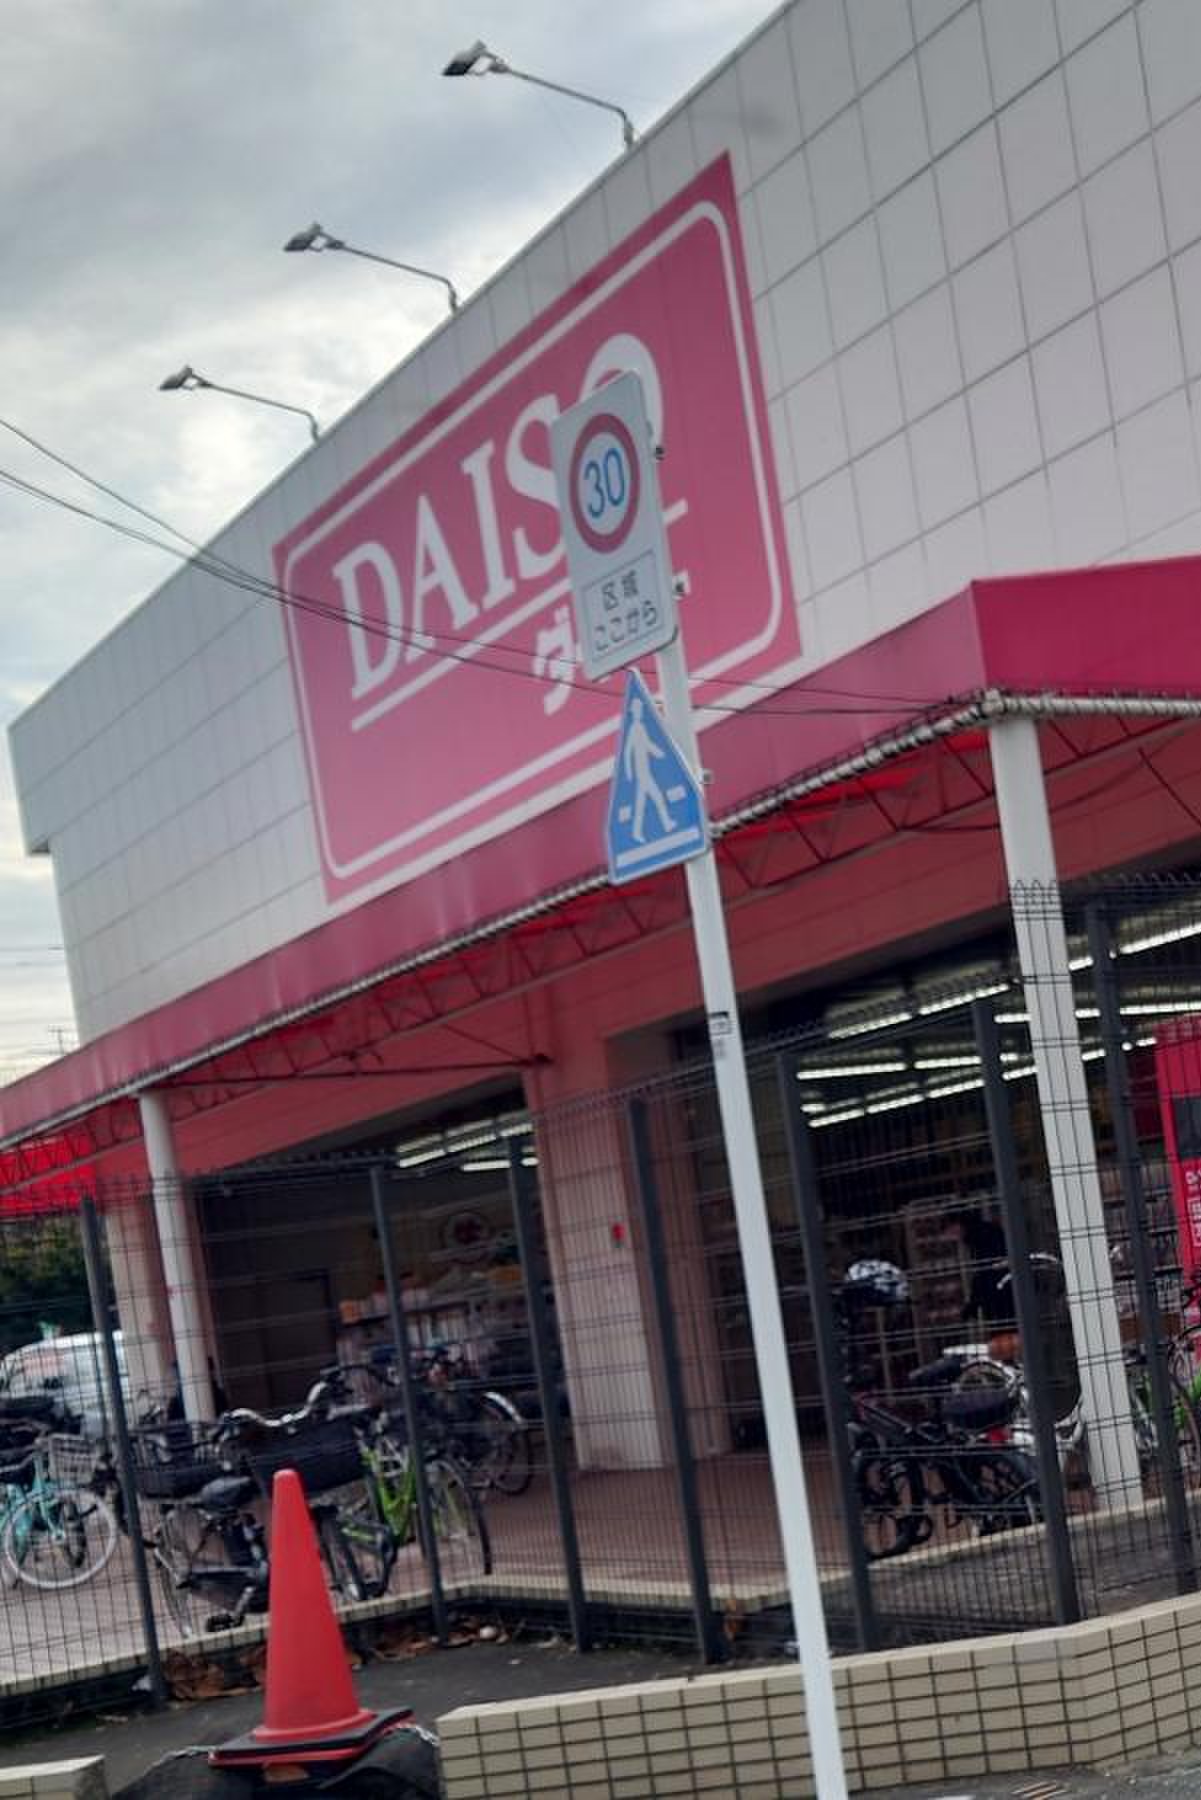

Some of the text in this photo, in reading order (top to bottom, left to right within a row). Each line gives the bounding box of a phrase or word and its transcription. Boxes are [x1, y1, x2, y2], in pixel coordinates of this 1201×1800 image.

[584, 448, 625, 518] 30
[601, 569, 638, 611] 区域
[594, 600, 658, 651] ここから
